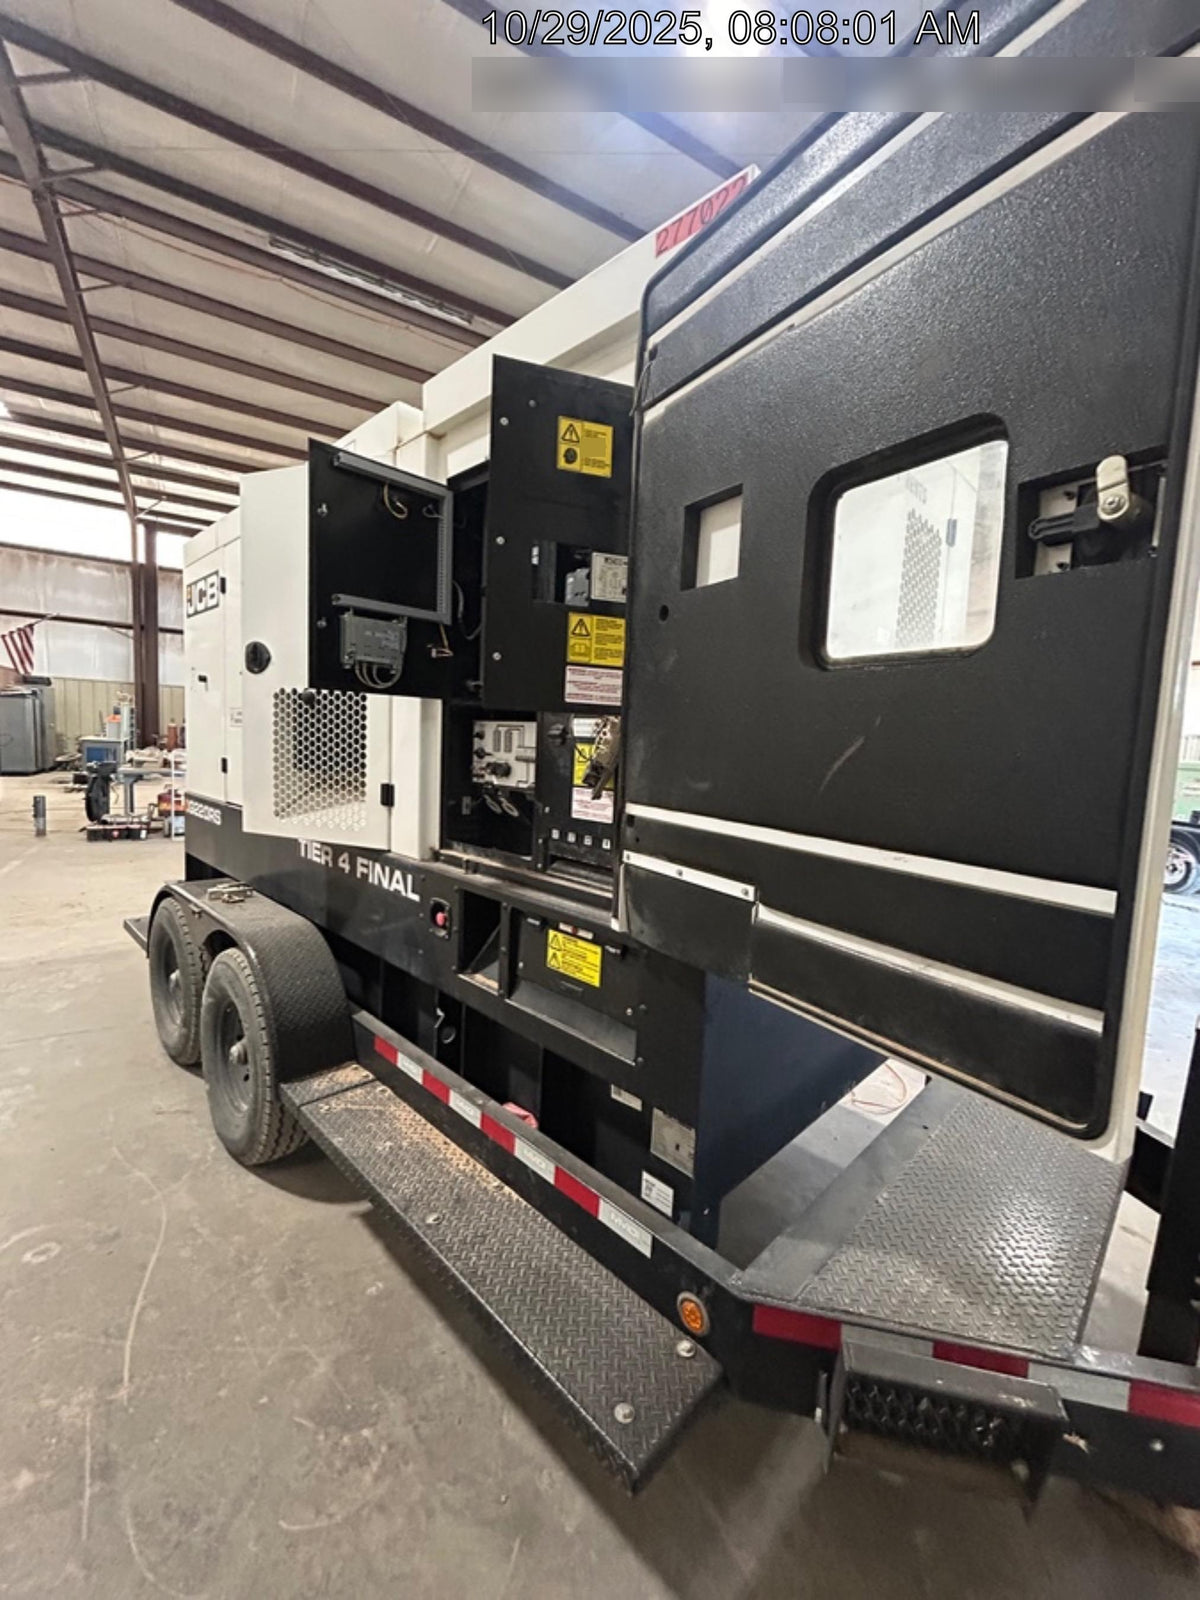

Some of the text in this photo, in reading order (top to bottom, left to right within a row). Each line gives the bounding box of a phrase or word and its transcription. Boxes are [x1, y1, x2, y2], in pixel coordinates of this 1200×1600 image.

[186, 570, 219, 617] JCB
[297, 838, 420, 903] TIER 4 FINAL
